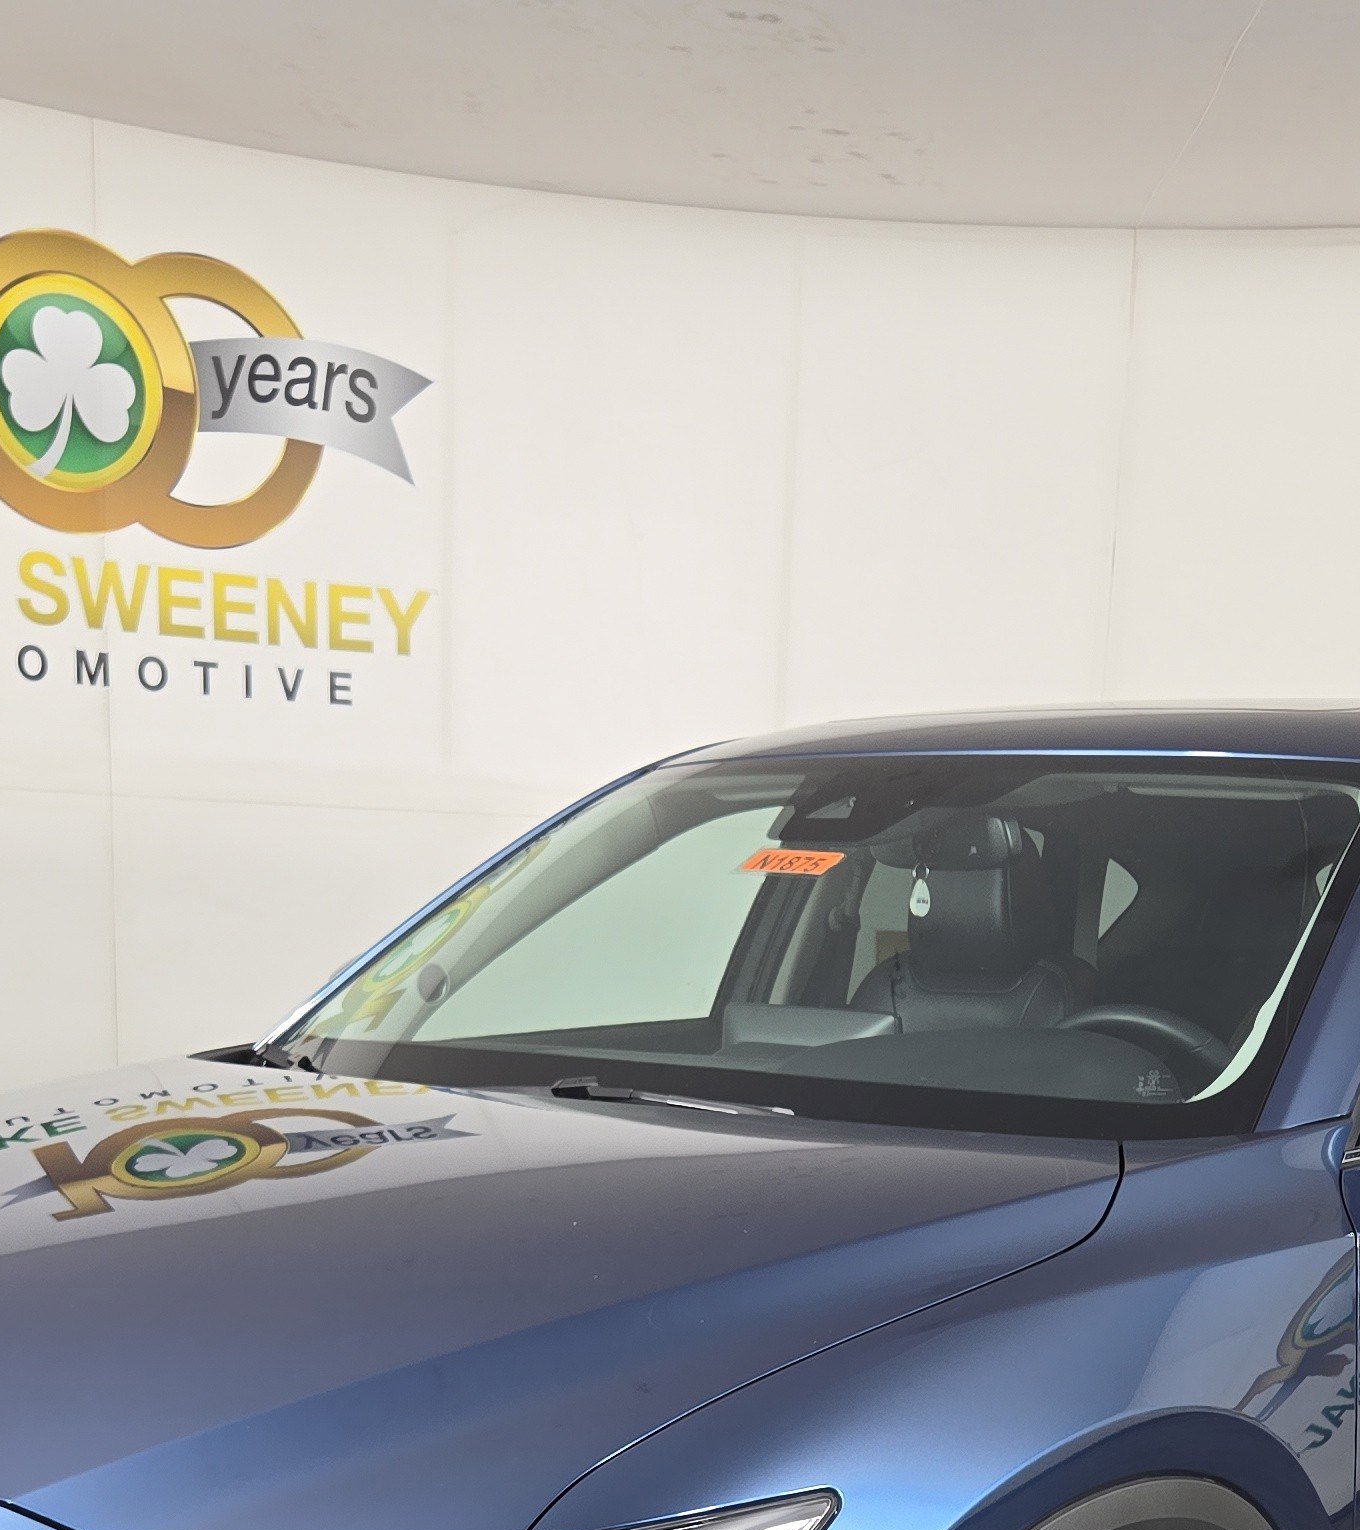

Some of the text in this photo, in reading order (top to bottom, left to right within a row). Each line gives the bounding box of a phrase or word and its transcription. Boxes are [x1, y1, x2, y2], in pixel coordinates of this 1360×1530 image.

[209, 352, 380, 424] years
[16, 550, 432, 656] SWEENEY
[750, 854, 827, 872] N1875
